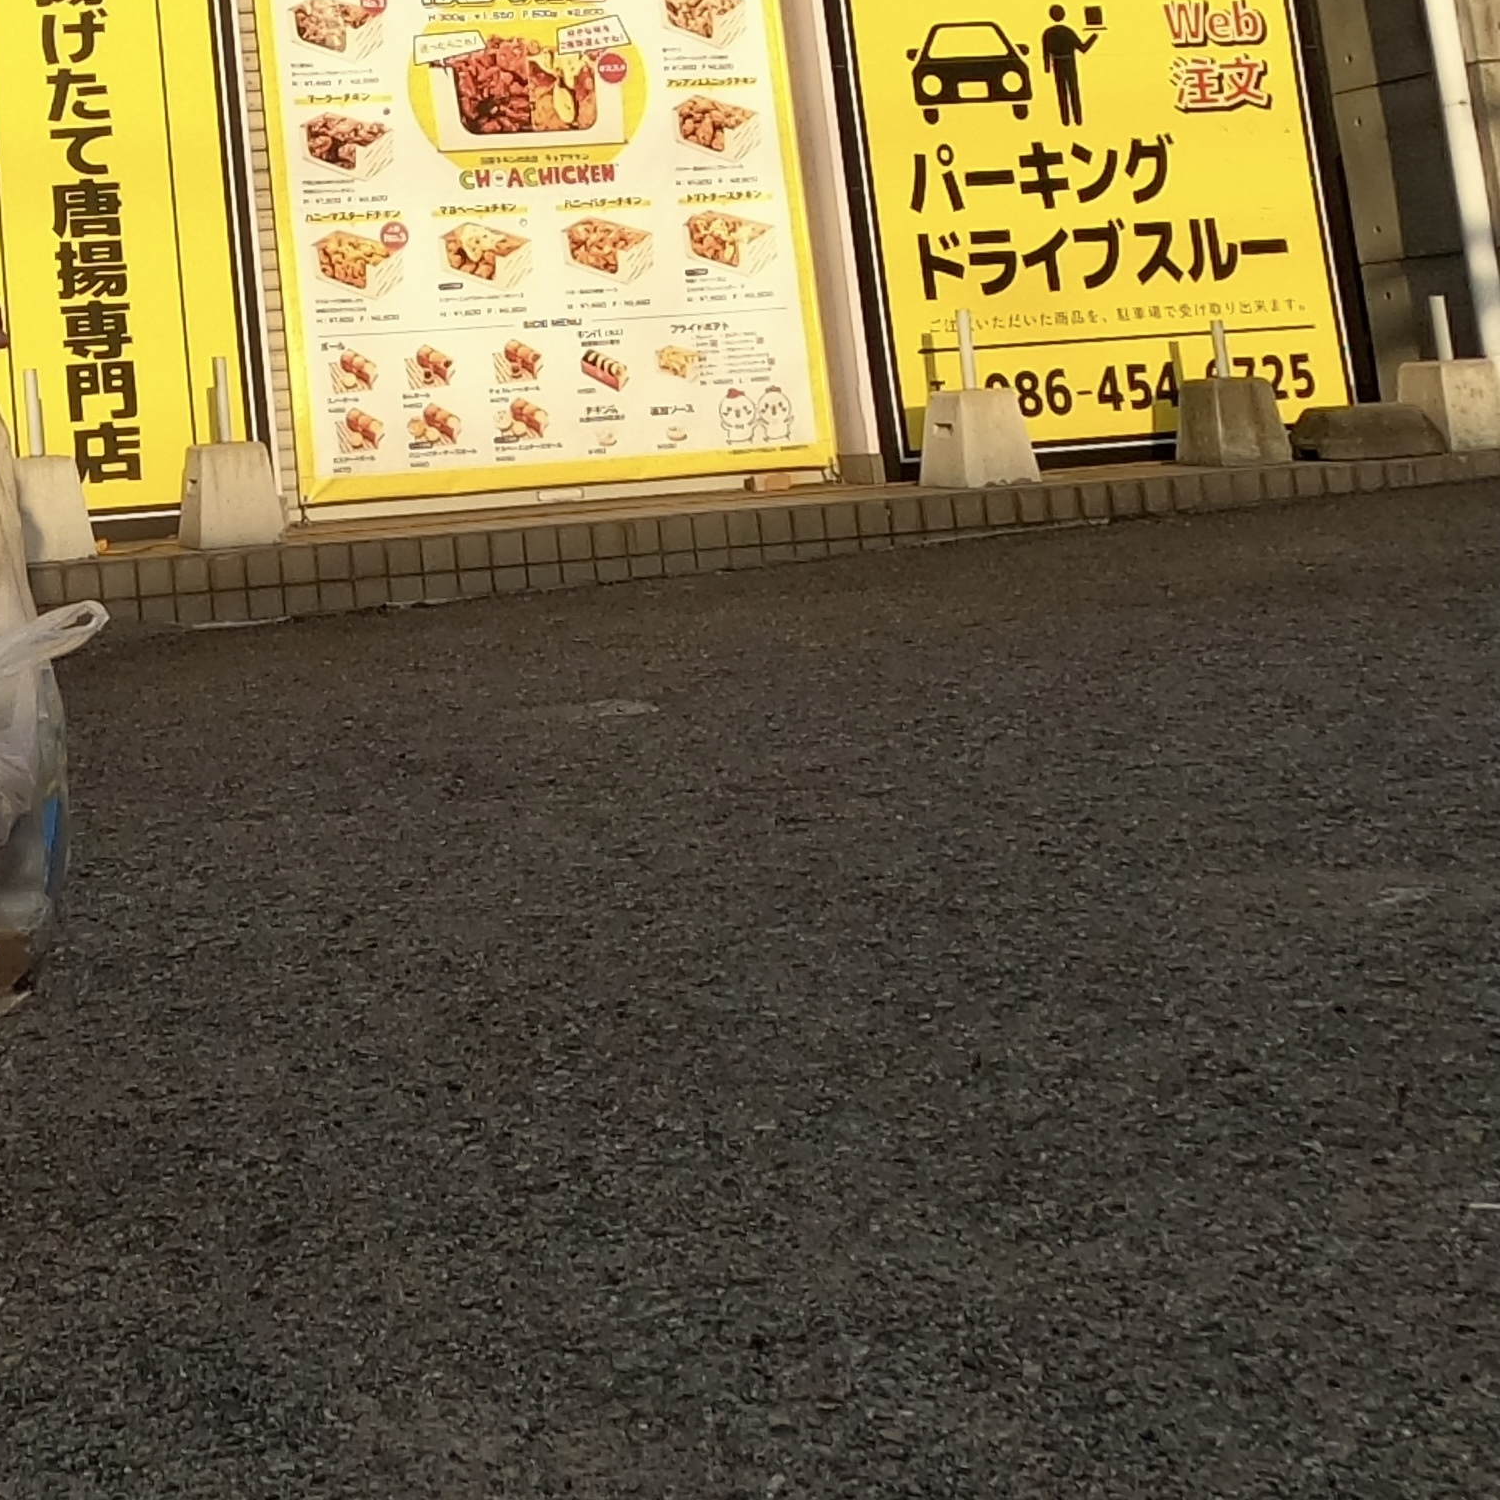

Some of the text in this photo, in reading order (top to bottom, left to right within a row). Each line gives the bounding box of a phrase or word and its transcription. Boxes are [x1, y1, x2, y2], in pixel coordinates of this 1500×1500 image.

[1169, 55, 1272, 113] 注文
[909, 132, 1175, 214] パーキング
[916, 216, 1289, 301] ドライブスルー
[929, 298, 1307, 334] ご注いただいた商品を、駐車場で受け取り出来ます。
